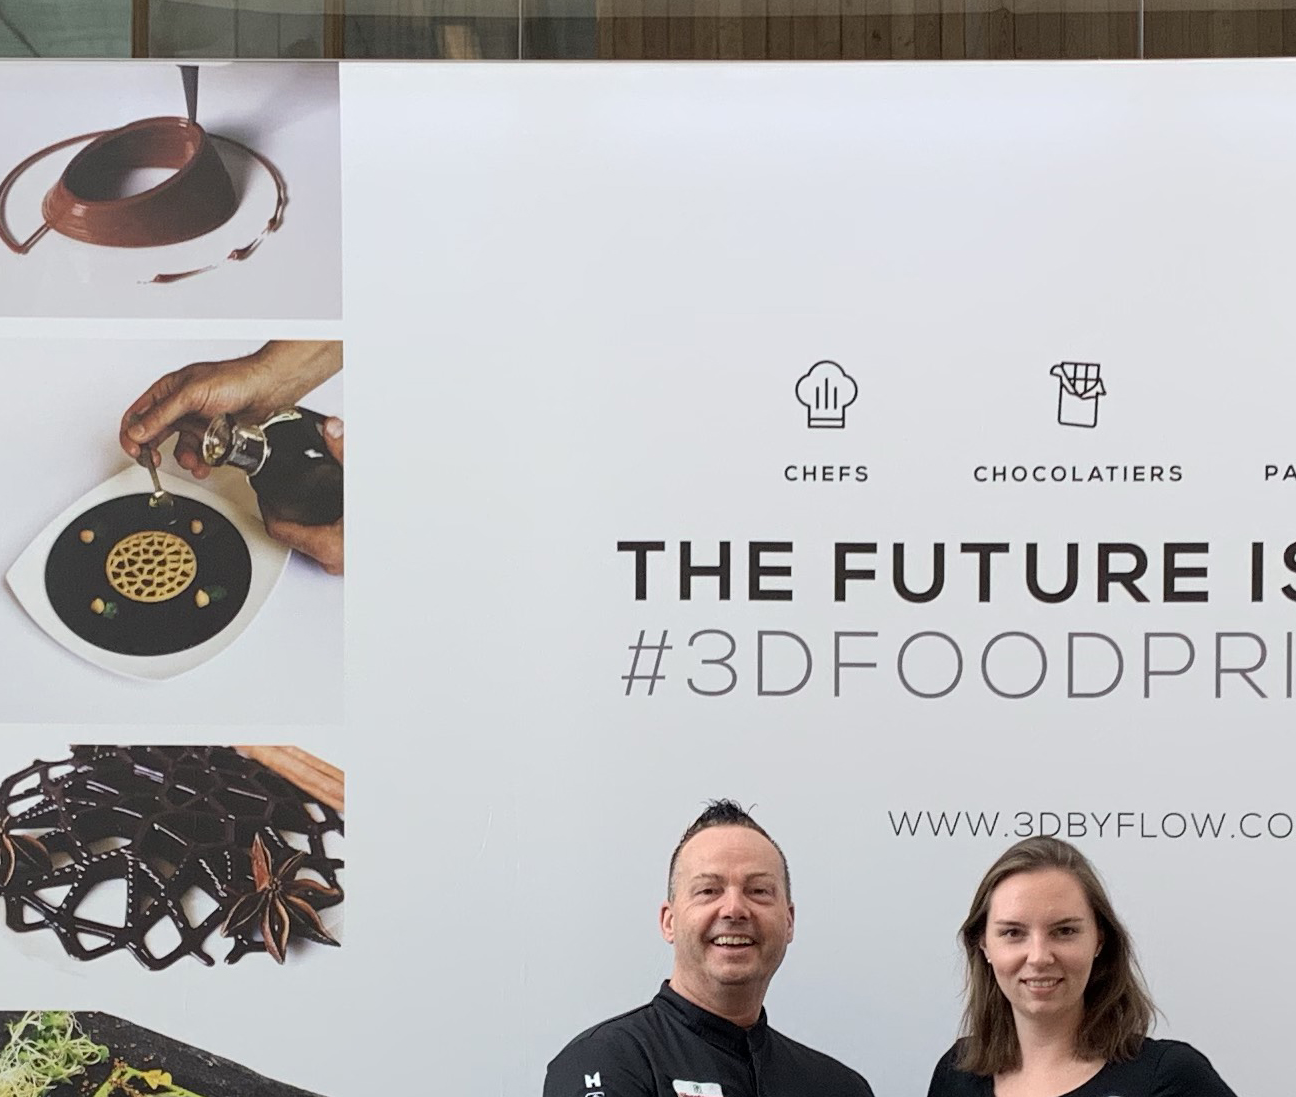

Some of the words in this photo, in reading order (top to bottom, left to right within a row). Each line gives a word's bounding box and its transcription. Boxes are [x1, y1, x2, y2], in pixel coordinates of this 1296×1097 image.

[785, 466, 869, 484] CHEFS
[974, 466, 1184, 484] CHOCOLATIERS
[617, 541, 794, 603] THE
[835, 543, 1210, 605] FUTURE
